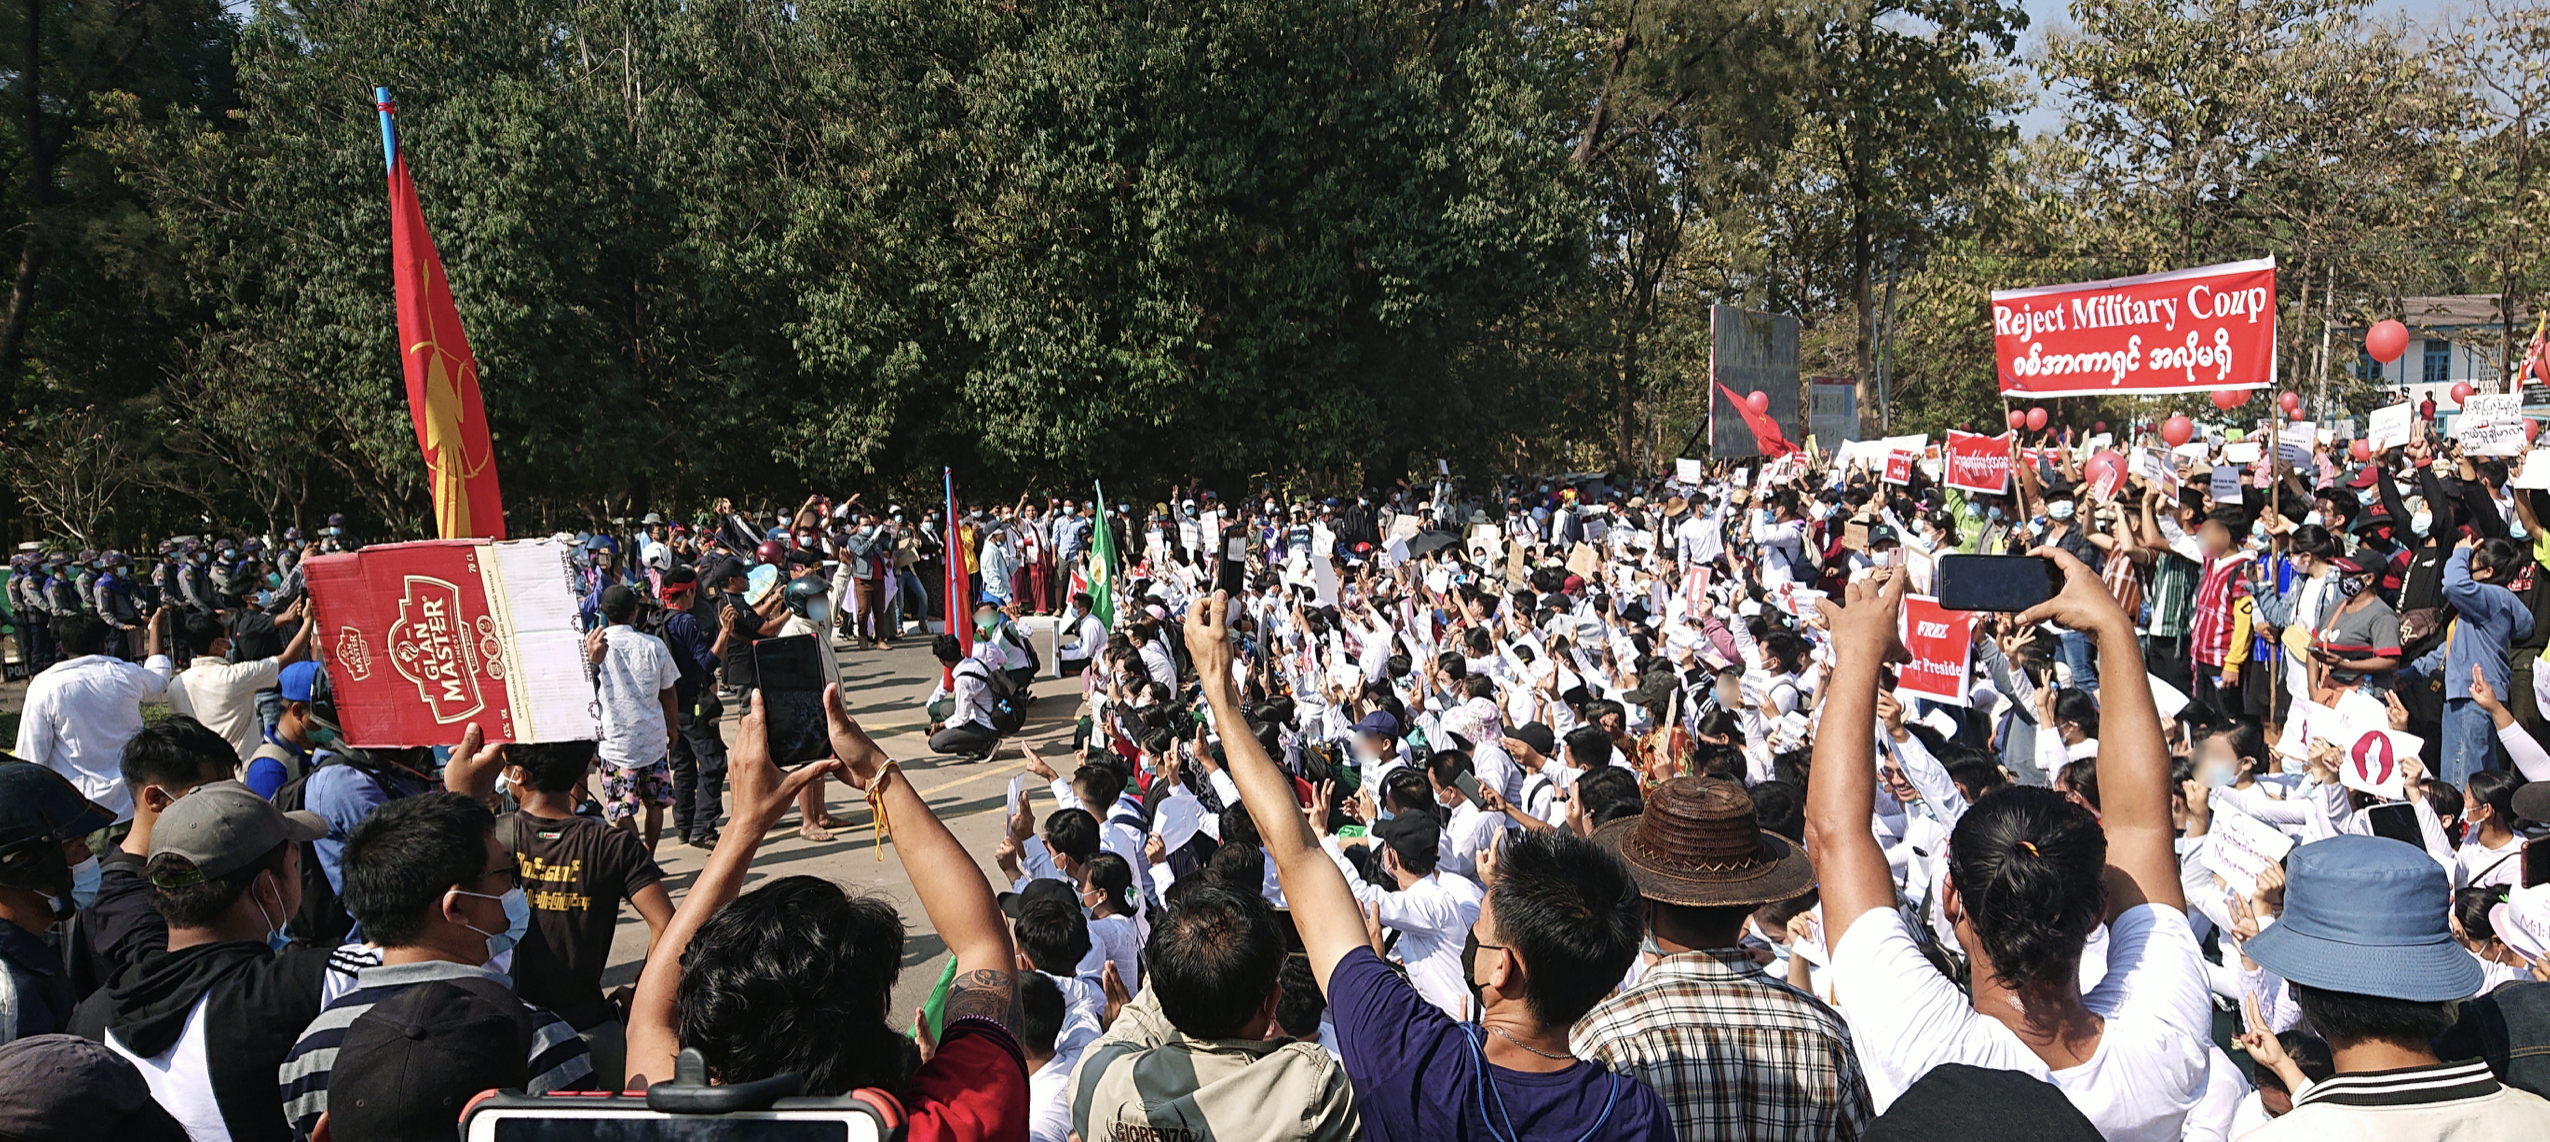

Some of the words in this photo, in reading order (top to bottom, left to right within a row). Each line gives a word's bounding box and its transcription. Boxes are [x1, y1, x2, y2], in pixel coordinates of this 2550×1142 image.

[1993, 303, 2065, 342] Reject
[2072, 294, 2178, 332] Military
[2187, 284, 2267, 324] Coup
[2149, 327, 2232, 383] အလိုမရှိ
[468, 563, 477, 573] 70
[487, 569, 495, 594] WHISKY
[423, 597, 466, 702] MASTER
[452, 634, 463, 664] FINEST
[1917, 620, 1950, 639] FREE
[349, 634, 365, 673] MASTER
[413, 622, 440, 681] GLAN
[511, 674, 523, 720] INTERNATIONAL
